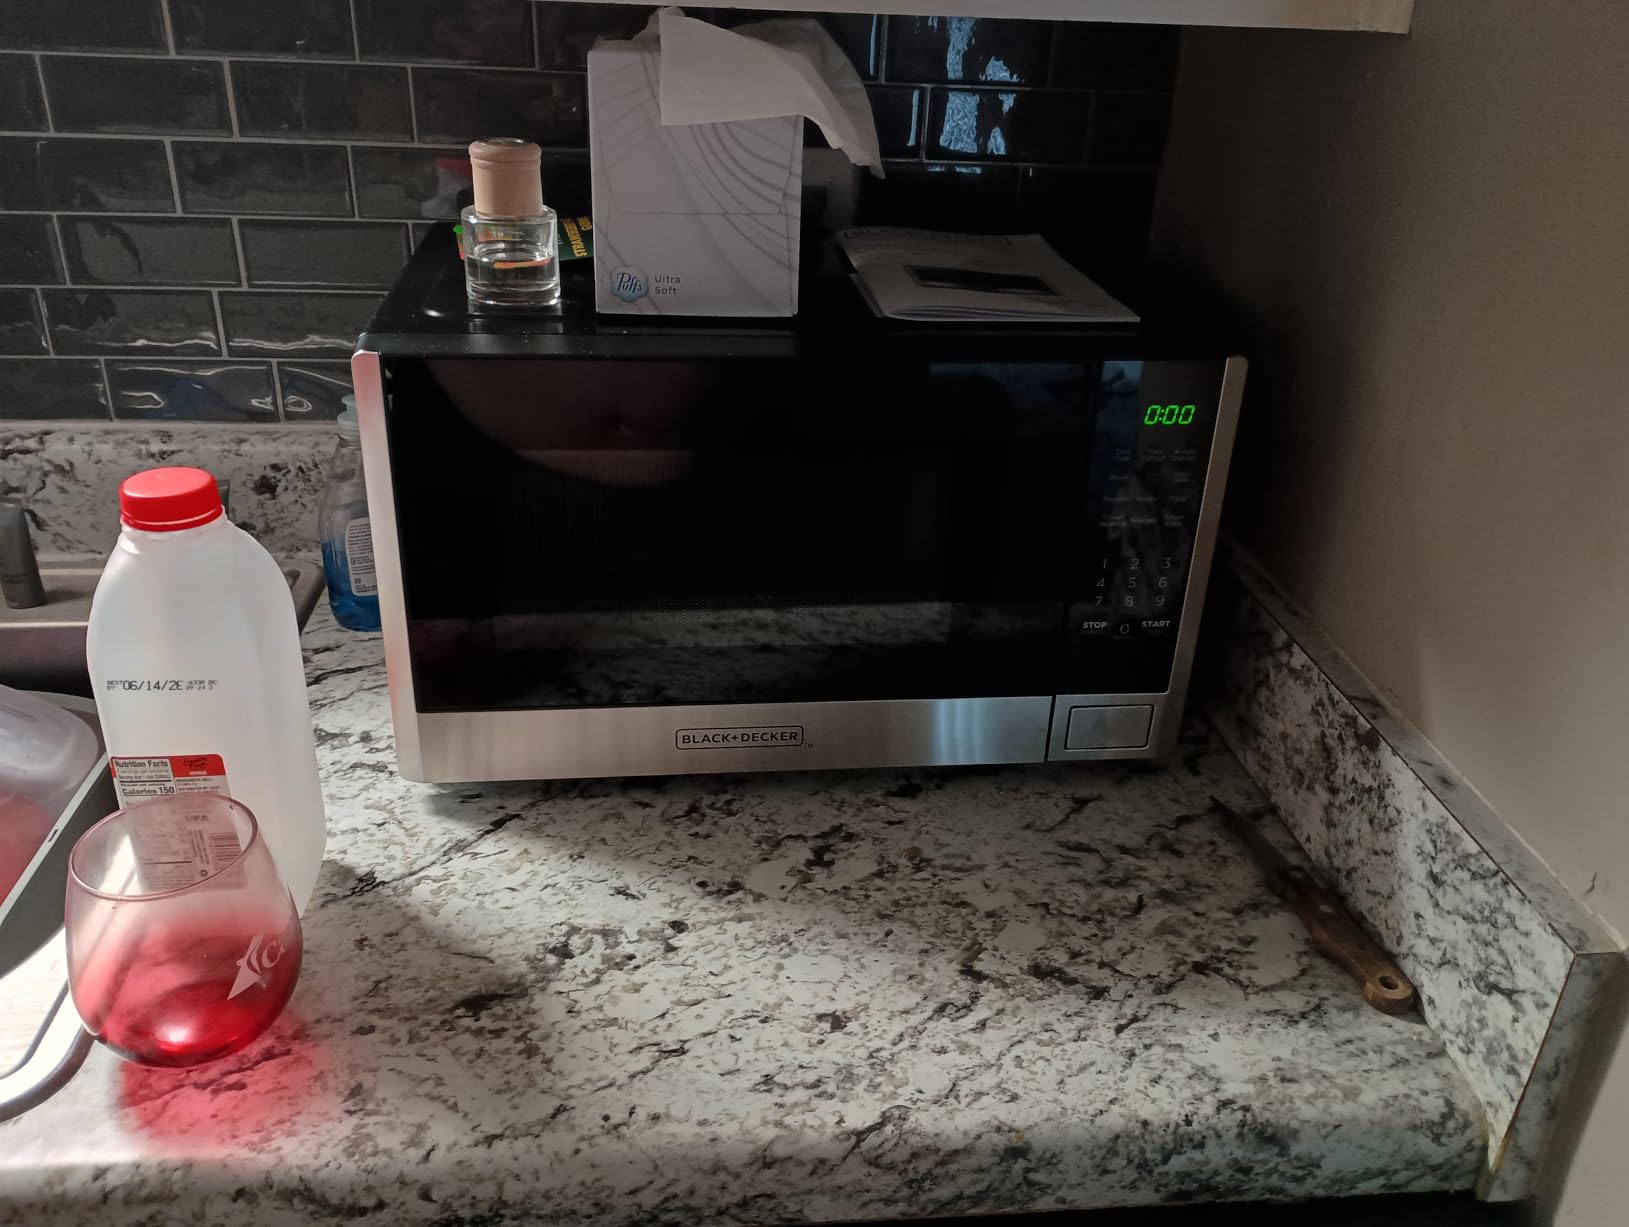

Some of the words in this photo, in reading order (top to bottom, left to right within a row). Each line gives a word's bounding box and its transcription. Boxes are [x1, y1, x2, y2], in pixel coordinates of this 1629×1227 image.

[616, 272, 642, 293] Puffs
[654, 274, 681, 284] Ultra
[655, 286, 678, 295] Soft
[1143, 403, 1197, 426] 0:00
[1129, 557, 1141, 570] 2
[1161, 557, 1172, 569] 3
[1095, 576, 1105, 588] 4
[1127, 576, 1137, 589] 5
[1158, 576, 1168, 588] 6
[1095, 595, 1105, 607] 7
[1124, 595, 1135, 607] 8
[1155, 595, 1165, 607] 9
[1082, 620, 1108, 629] STOP
[1119, 623, 1131, 635] 0
[1140, 619, 1172, 628] START
[681, 731, 799, 744] BLACK+DECKER
[114, 759, 146, 768] Nutrition
[147, 759, 169, 768] Facts
[158, 786, 175, 794] 150
